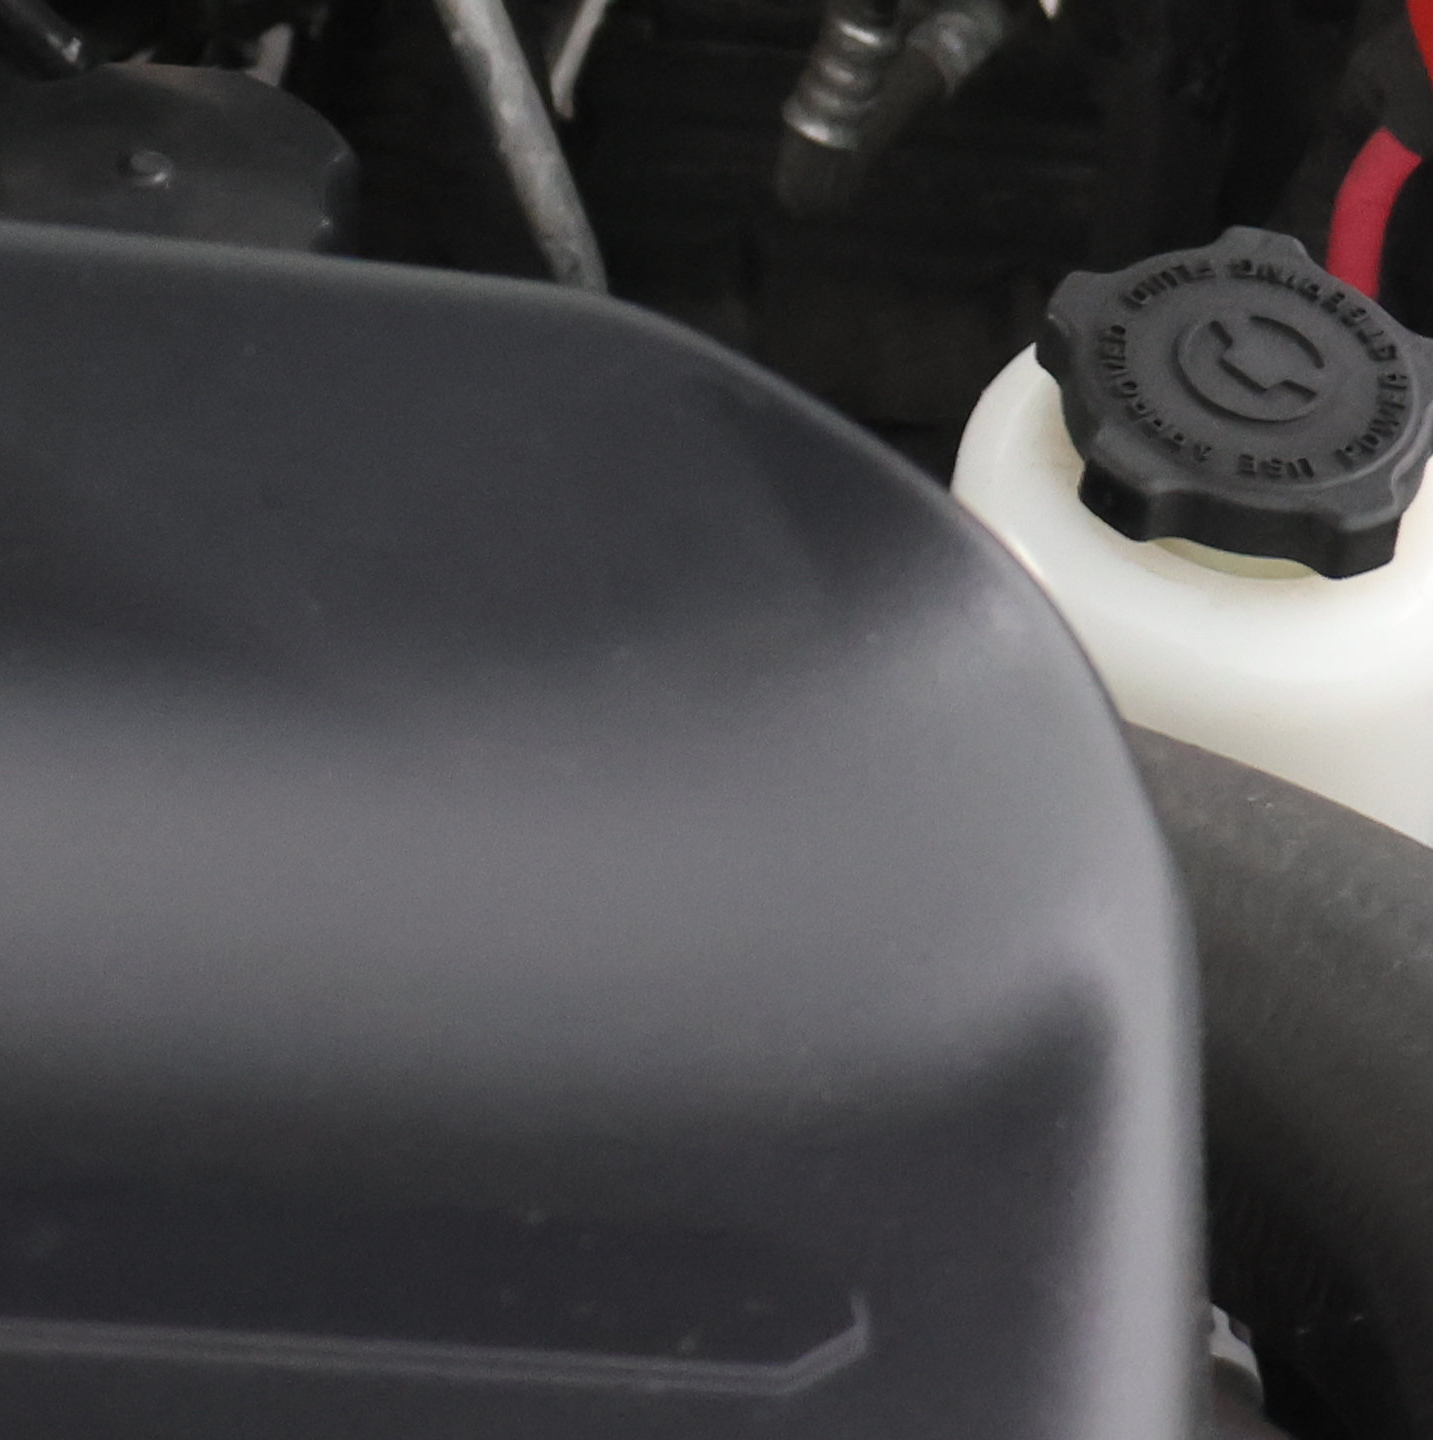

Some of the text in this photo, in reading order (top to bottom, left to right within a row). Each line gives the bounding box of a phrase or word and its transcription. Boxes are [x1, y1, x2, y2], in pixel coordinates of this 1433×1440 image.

[1097, 322, 1316, 479] USE APPROVED
[1122, 257, 1408, 469] POWER STEERING FLUID
